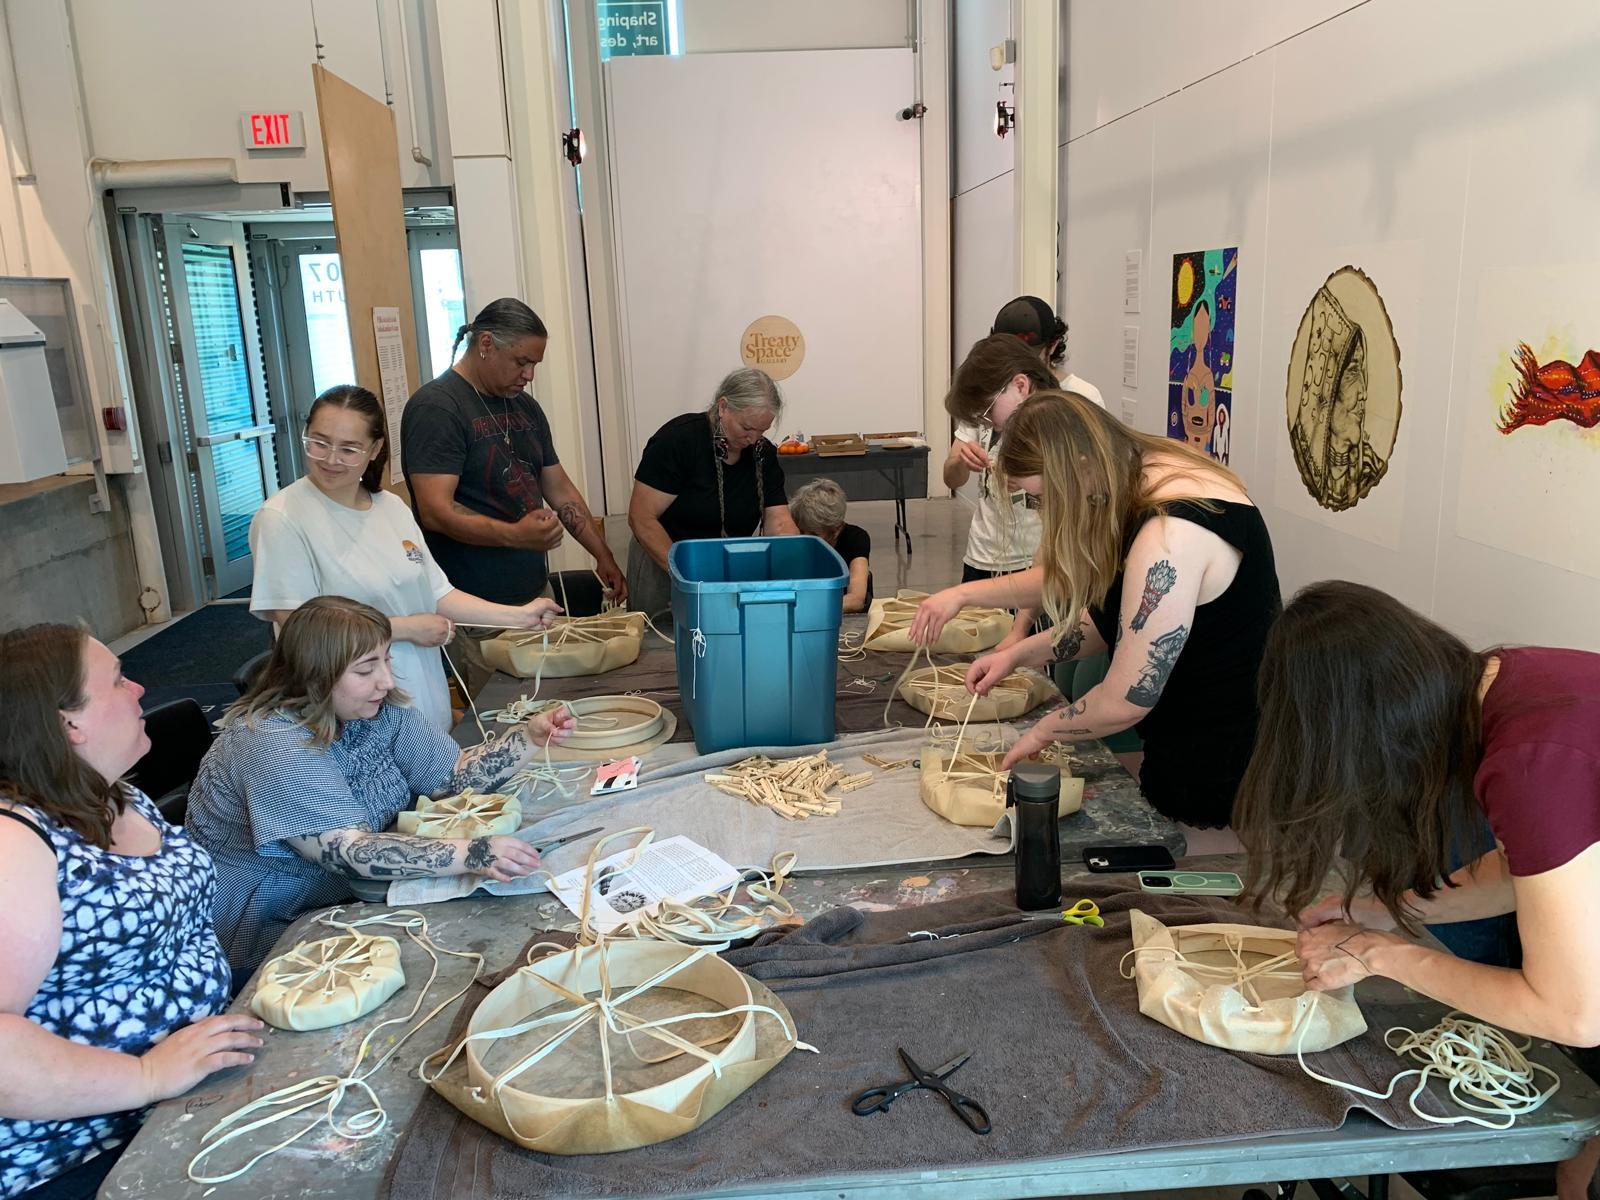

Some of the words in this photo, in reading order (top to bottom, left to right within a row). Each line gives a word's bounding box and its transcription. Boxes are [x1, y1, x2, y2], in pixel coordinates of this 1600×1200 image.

[251, 114, 289, 145] EXIT
[750, 332, 800, 351] Treaty
[745, 343, 792, 364] Space
